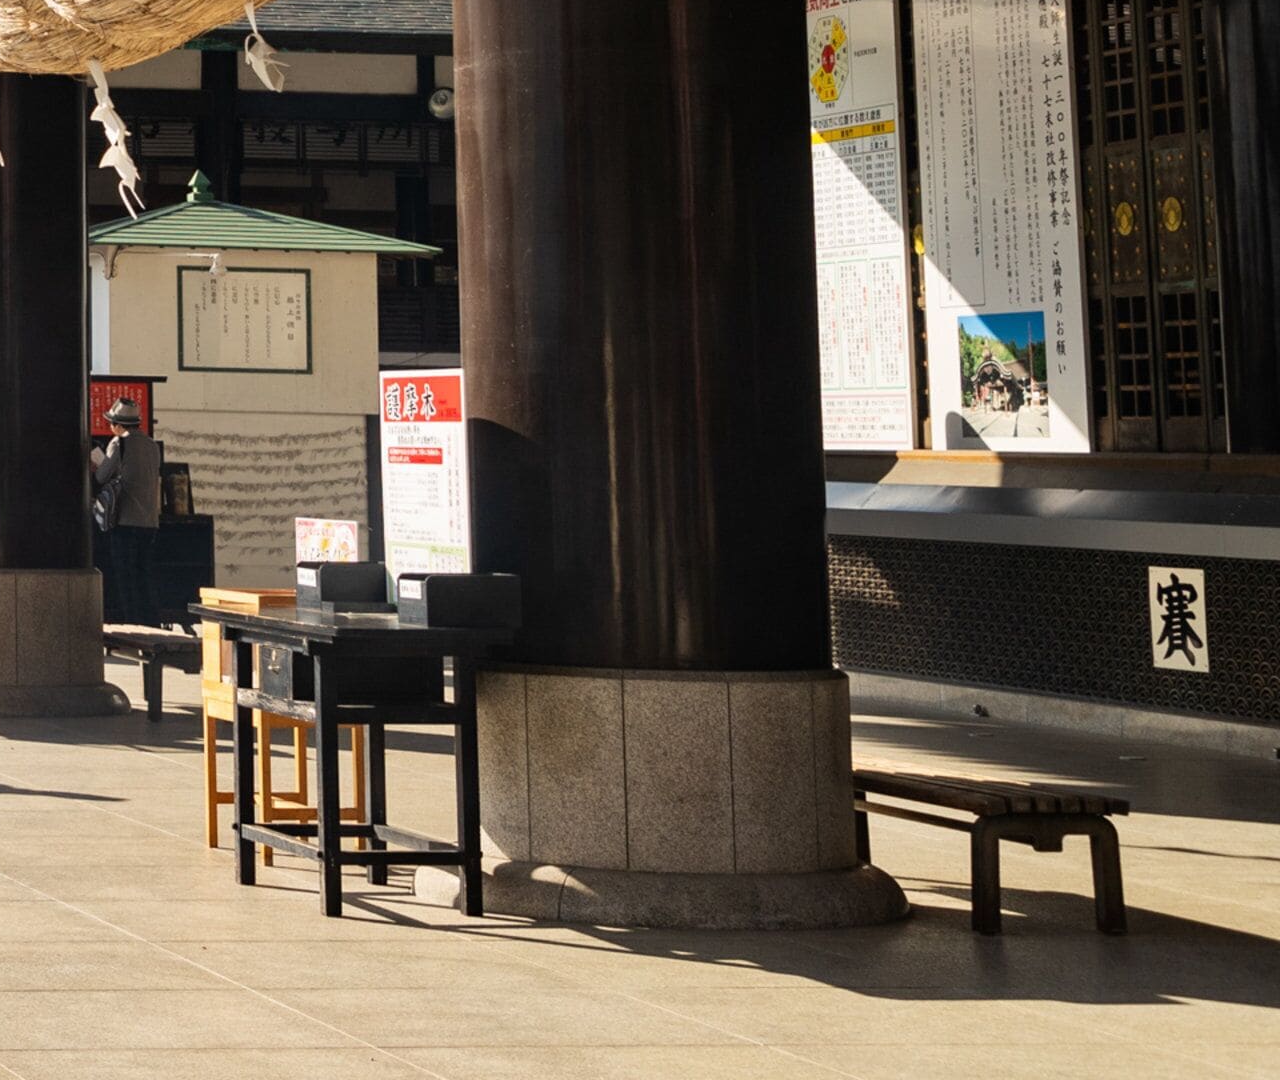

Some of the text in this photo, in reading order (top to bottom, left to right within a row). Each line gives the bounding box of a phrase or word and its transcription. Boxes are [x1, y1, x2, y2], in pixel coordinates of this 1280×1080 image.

[386, 383, 435, 420] 護摩木
[1157, 572, 1204, 667] 賽
